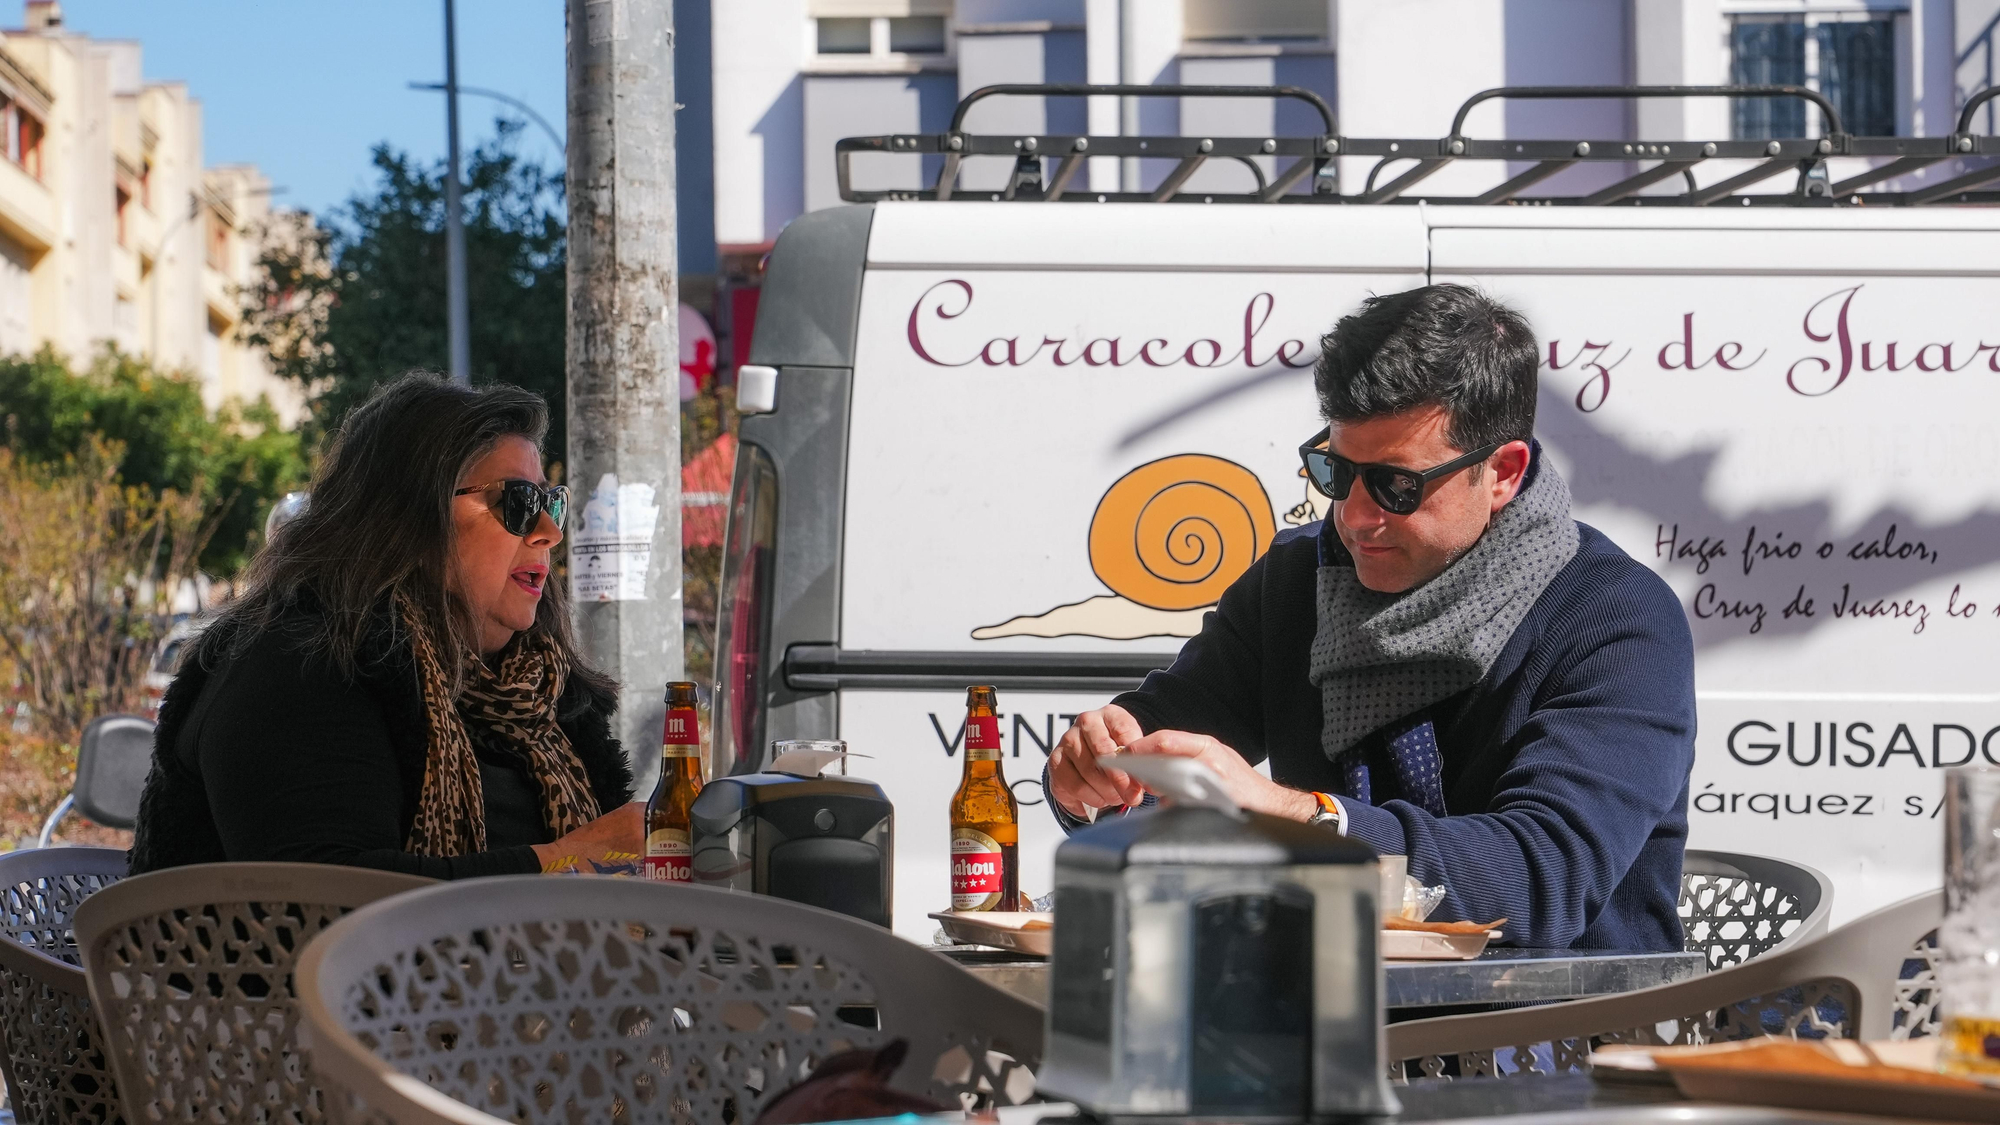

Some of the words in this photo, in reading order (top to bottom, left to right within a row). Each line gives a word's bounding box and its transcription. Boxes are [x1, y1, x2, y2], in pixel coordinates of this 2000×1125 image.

[907, 279, 1318, 368] Caracole
[1657, 312, 1768, 371] de
[1786, 283, 2000, 398] Juar
[1656, 523, 1727, 575] Haga
[1816, 541, 1834, 559] o
[1847, 523, 1938, 565] calor,
[1694, 583, 1768, 635] Cruz
[1783, 584, 1815, 619] de
[1832, 582, 1931, 635] Juarez
[1946, 584, 1977, 618] lo
[1694, 783, 1875, 820] árquez
[1904, 795, 1948, 819] s/
[645, 861, 691, 880] Maho
